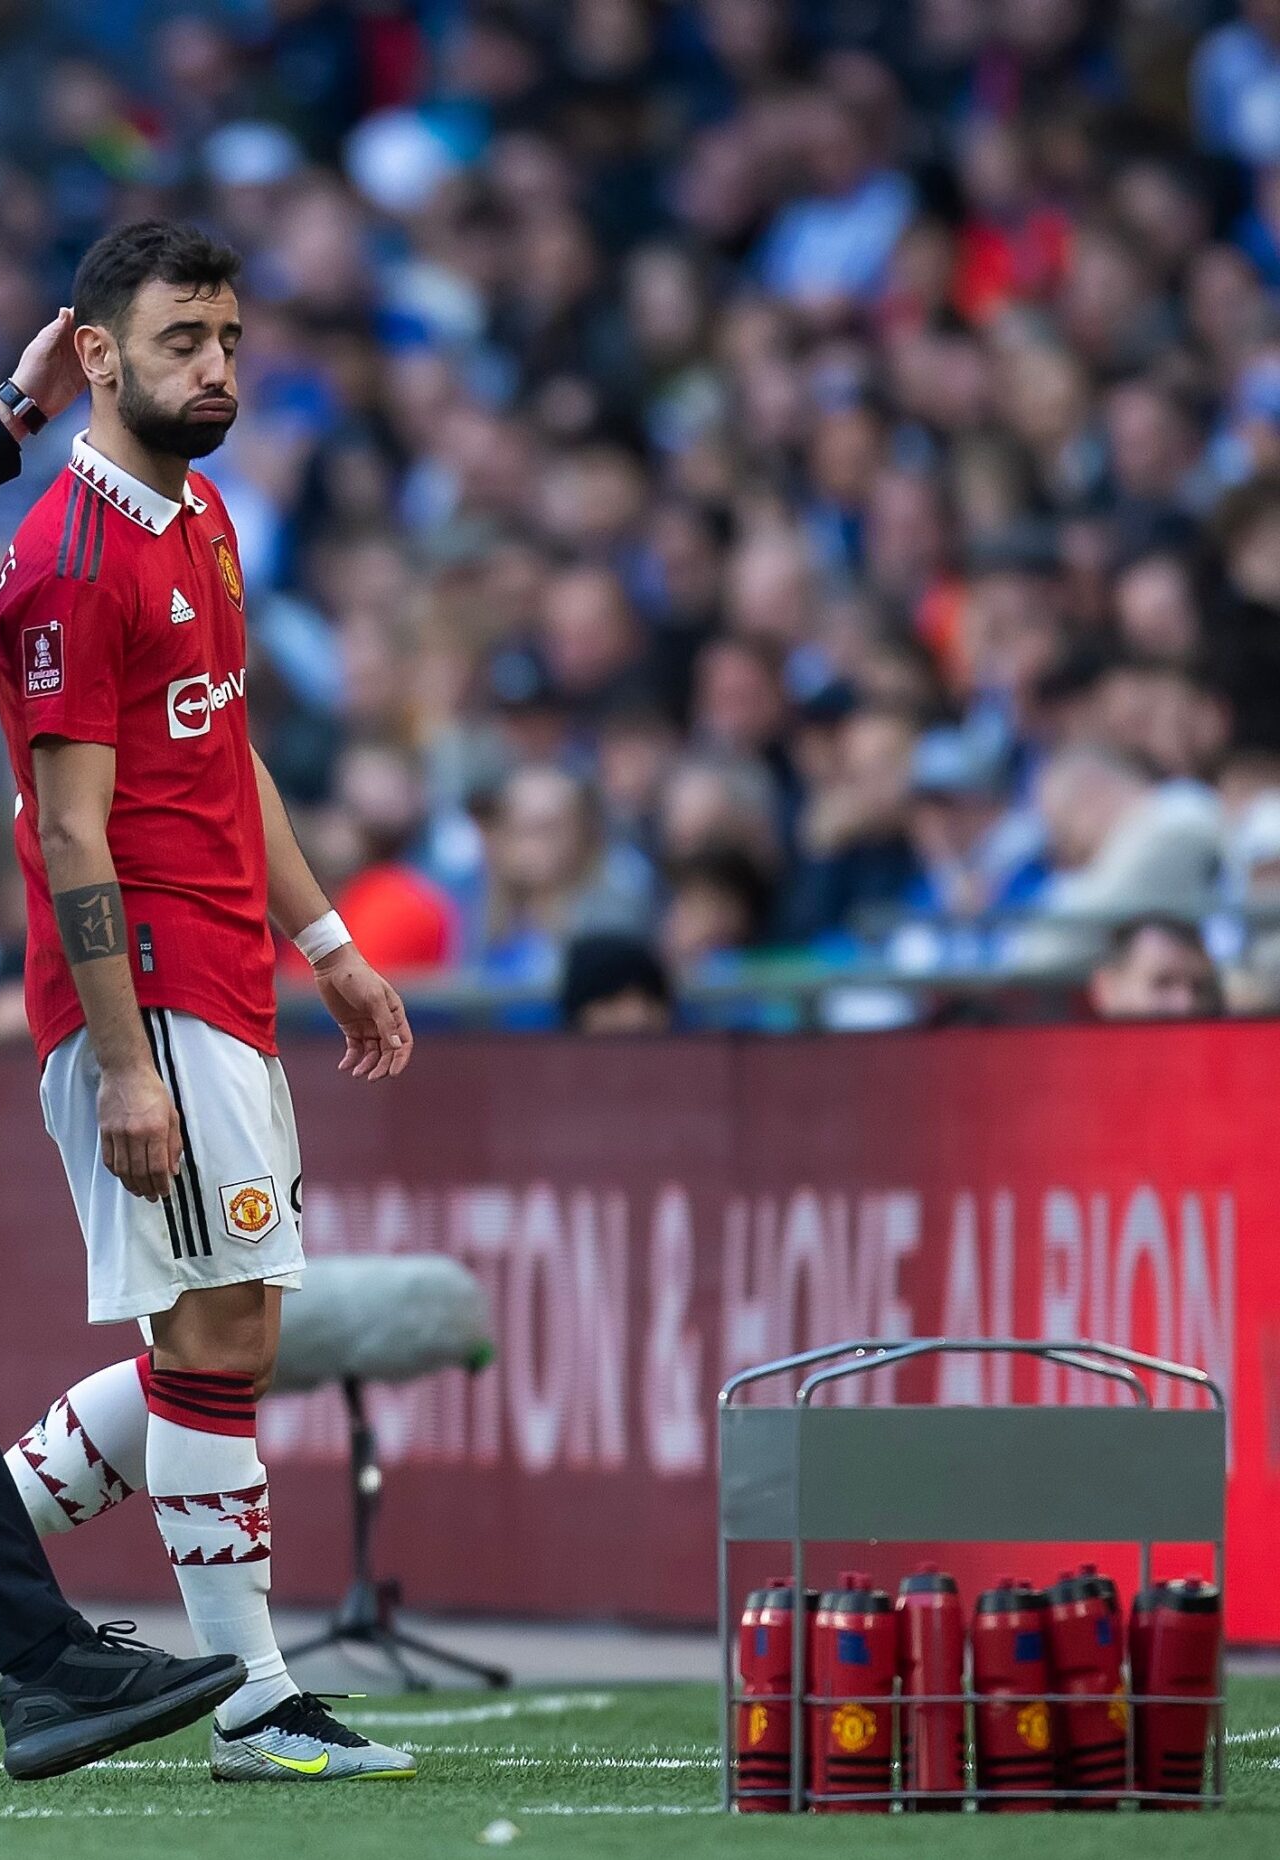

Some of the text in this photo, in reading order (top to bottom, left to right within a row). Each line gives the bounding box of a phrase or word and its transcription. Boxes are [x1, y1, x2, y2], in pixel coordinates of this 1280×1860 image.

[28, 669, 60, 681] Emirates
[28, 677, 60, 692] FA CUP
[645, 1186, 706, 1473] &
